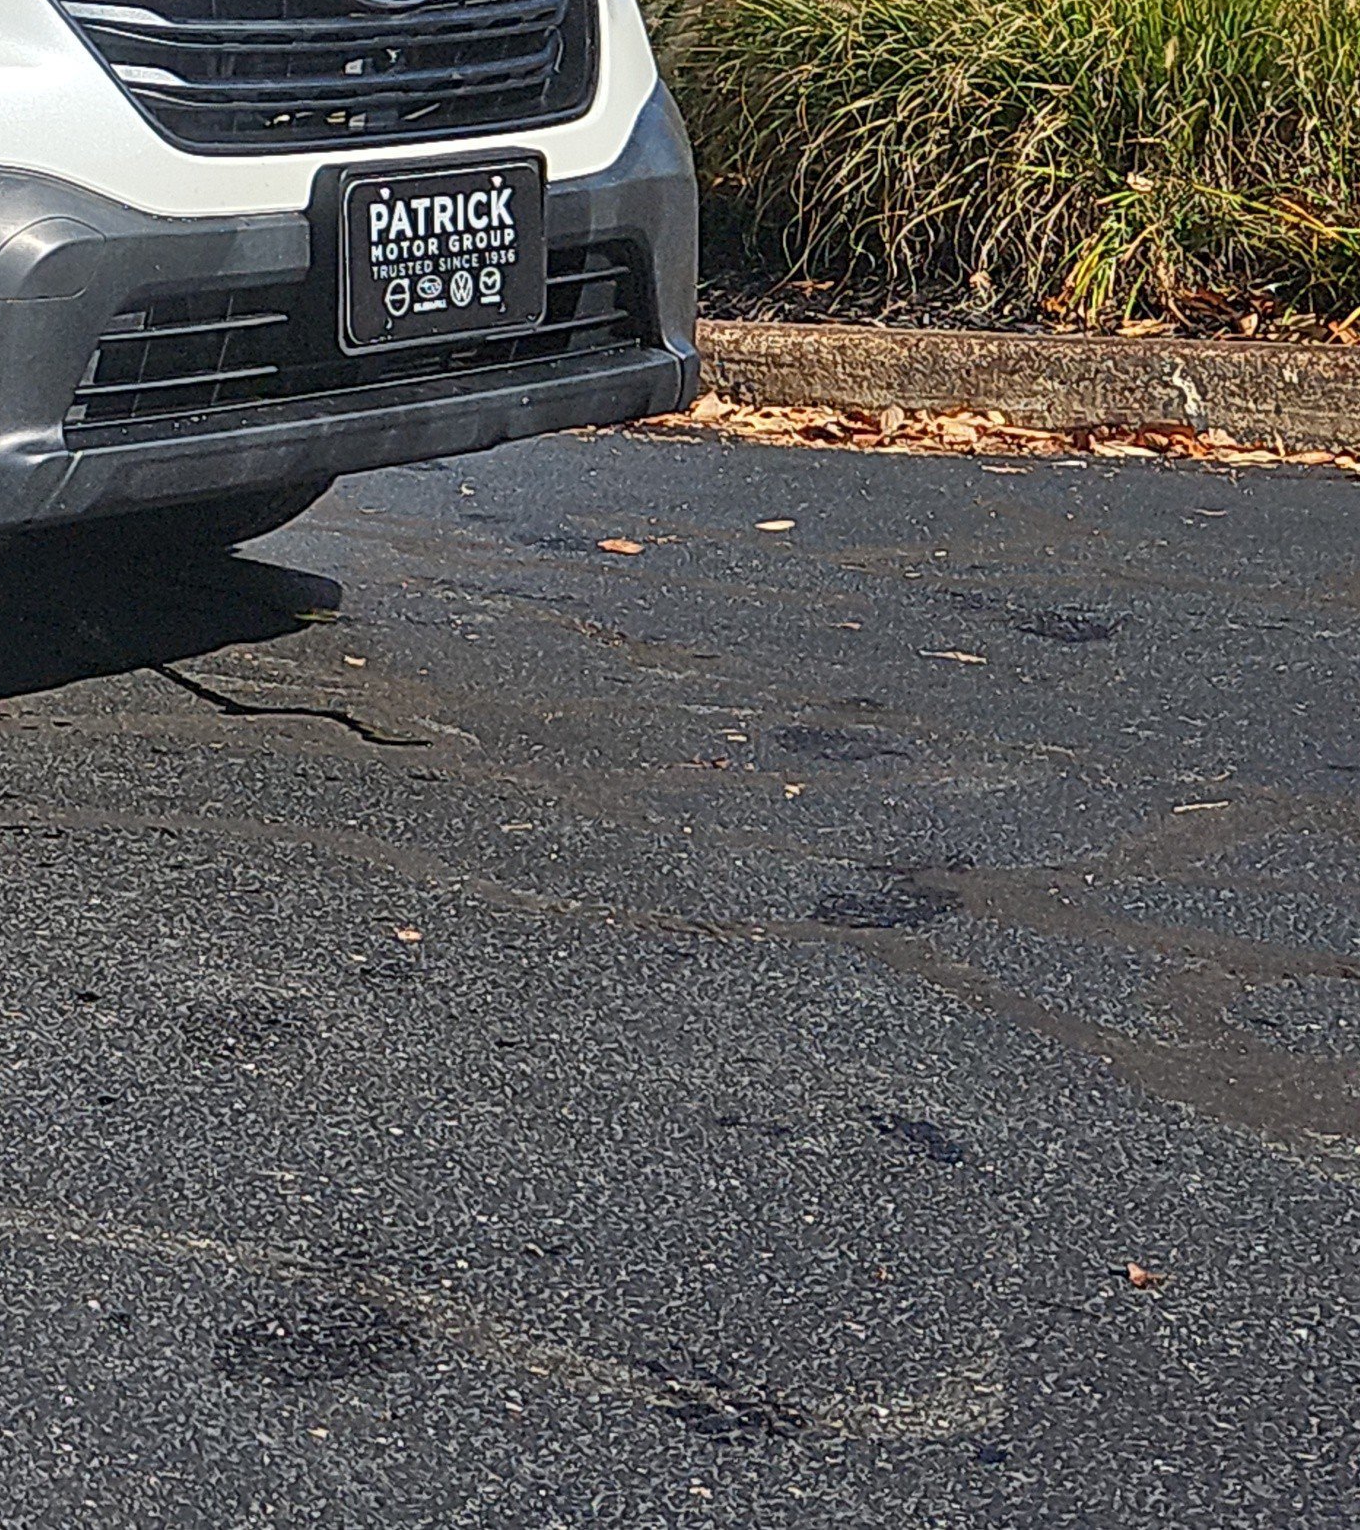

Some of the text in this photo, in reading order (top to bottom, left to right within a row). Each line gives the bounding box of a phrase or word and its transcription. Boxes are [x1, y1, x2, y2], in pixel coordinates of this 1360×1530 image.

[369, 188, 514, 242] PATRICK
[371, 228, 516, 263] MOTOR GROUP
[371, 249, 516, 280] TRUSTED SINCE 1936
